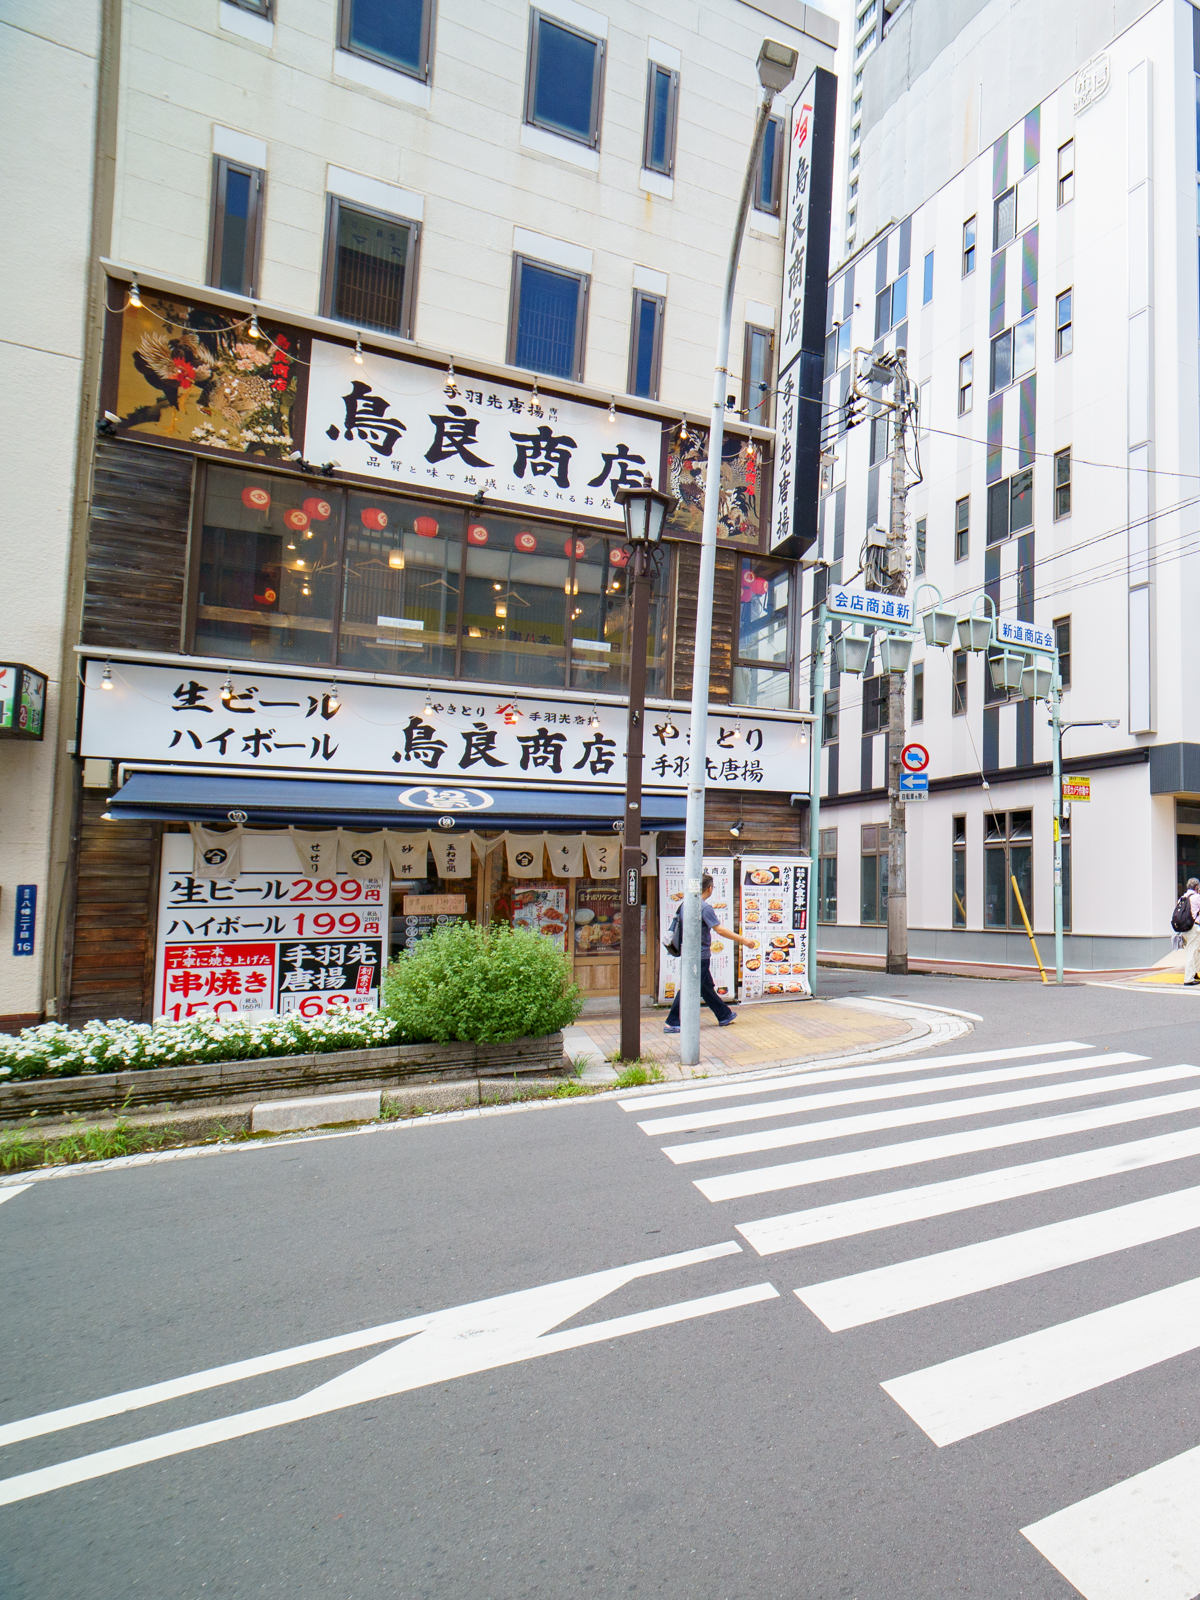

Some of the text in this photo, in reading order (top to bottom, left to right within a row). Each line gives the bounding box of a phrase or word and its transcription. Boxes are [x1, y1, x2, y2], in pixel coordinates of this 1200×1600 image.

[785, 156, 809, 345] 鳥良商店
[270, 332, 292, 392] 鳥良商店
[325, 380, 646, 496] 鳥良商店
[776, 373, 795, 540] 手羽先唐揚
[366, 455, 612, 509] 品質と味で地域に愛されるお店
[1002, 622, 1053, 647] 新道商店会
[172, 680, 342, 720] 生ビール
[168, 727, 340, 762] ハイボール
[391, 715, 617, 776] 鳥良商店
[652, 723, 764, 752] やとり
[310, 843, 321, 873] せせり
[401, 844, 414, 874] 砂肝
[561, 845, 570, 873] もも
[598, 847, 608, 873] つくね
[169, 876, 381, 906] 生ビール 299円
[20, 900, 31, 939] 八幡二丁目
[166, 912, 380, 937] ハイボール 199円
[17, 942, 31, 951] 16
[169, 947, 224, 957] 一本一本
[282, 943, 378, 967] 手羽先
[169, 955, 271, 969] 丁寧に焼き上げた
[168, 968, 268, 998] 串焼き
[280, 967, 347, 992] 唐揚
[357, 966, 373, 994] 創業の味
